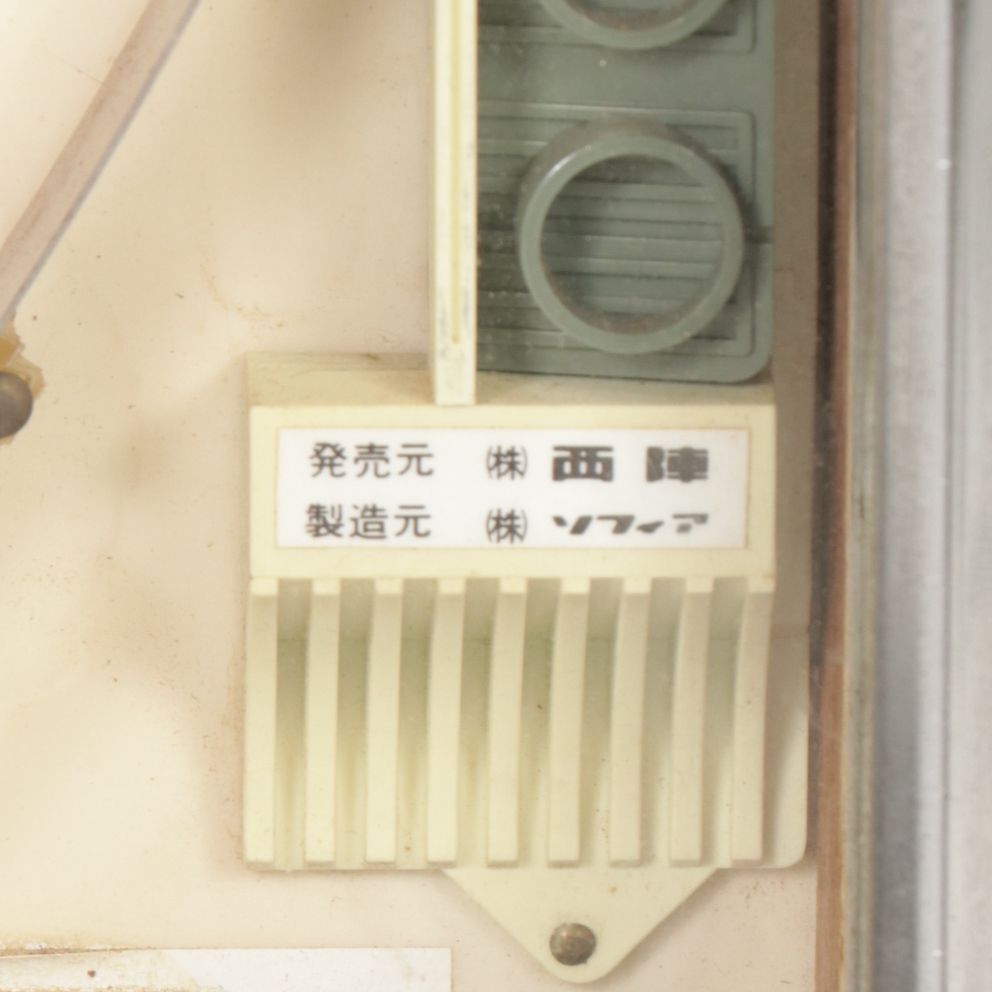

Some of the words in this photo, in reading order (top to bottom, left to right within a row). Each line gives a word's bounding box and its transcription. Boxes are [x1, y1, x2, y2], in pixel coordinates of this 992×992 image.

[309, 441, 435, 478] 発売元
[305, 502, 433, 539] 製造元
